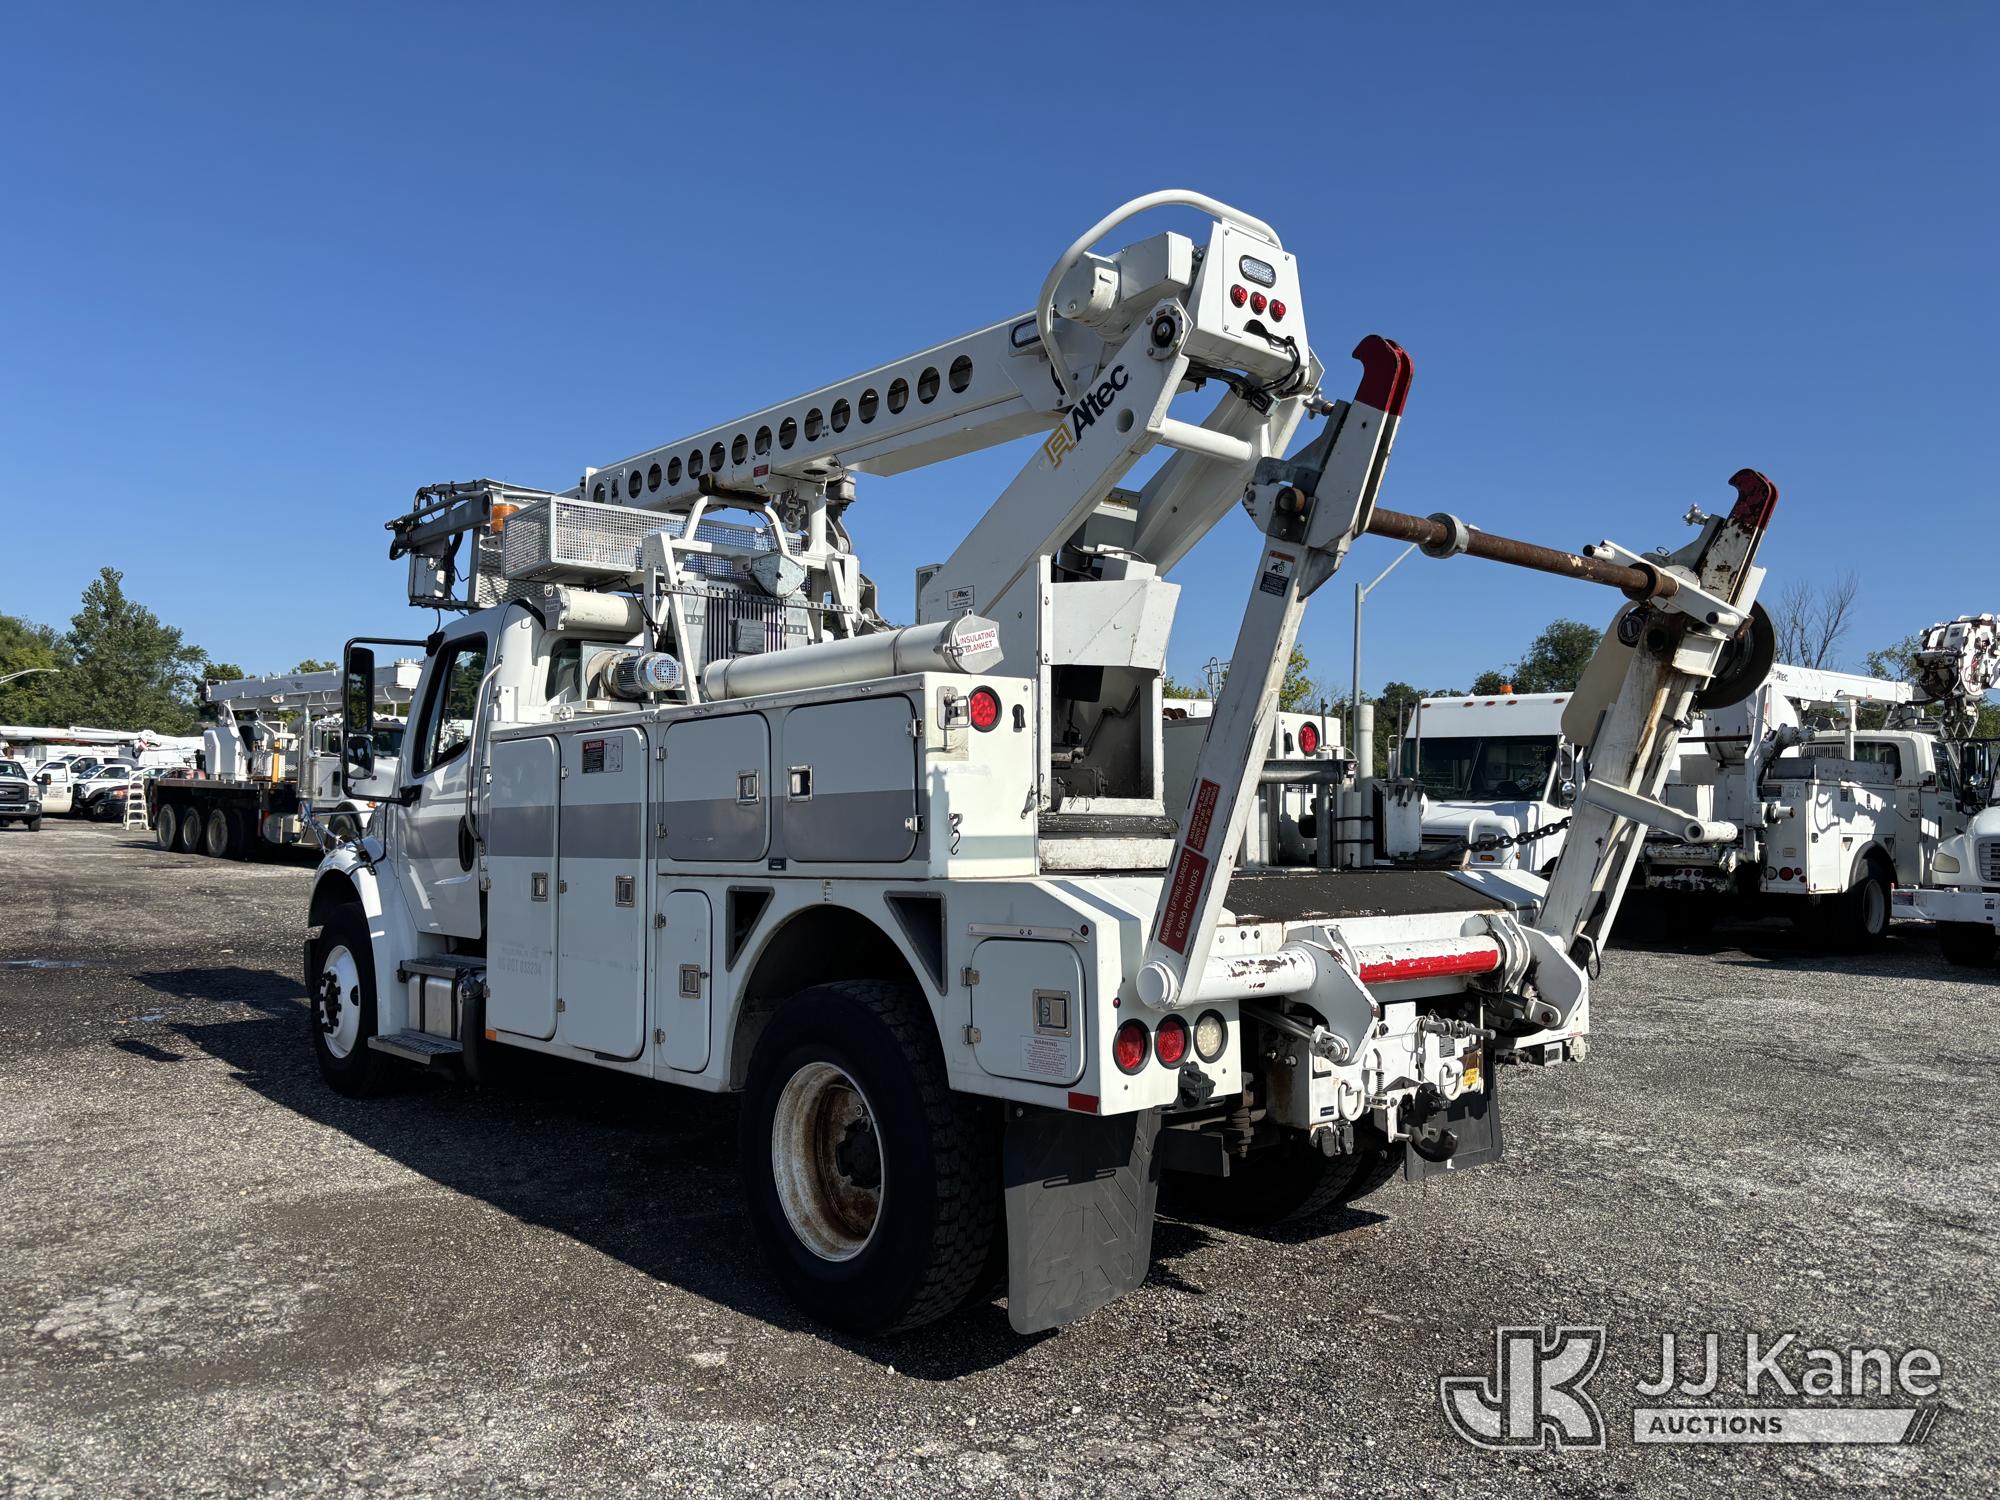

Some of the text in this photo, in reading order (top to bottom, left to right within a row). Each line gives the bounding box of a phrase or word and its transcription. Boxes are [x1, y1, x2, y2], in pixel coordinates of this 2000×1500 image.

[1072, 364, 1129, 442] Altec
[960, 630, 996, 645] INSULATING
[965, 640, 992, 653] BLANKET
[1161, 852, 1191, 943] MAXIMUM LIFTING CAPACITY
[1176, 868, 1200, 938] 6,000 POUNDS
